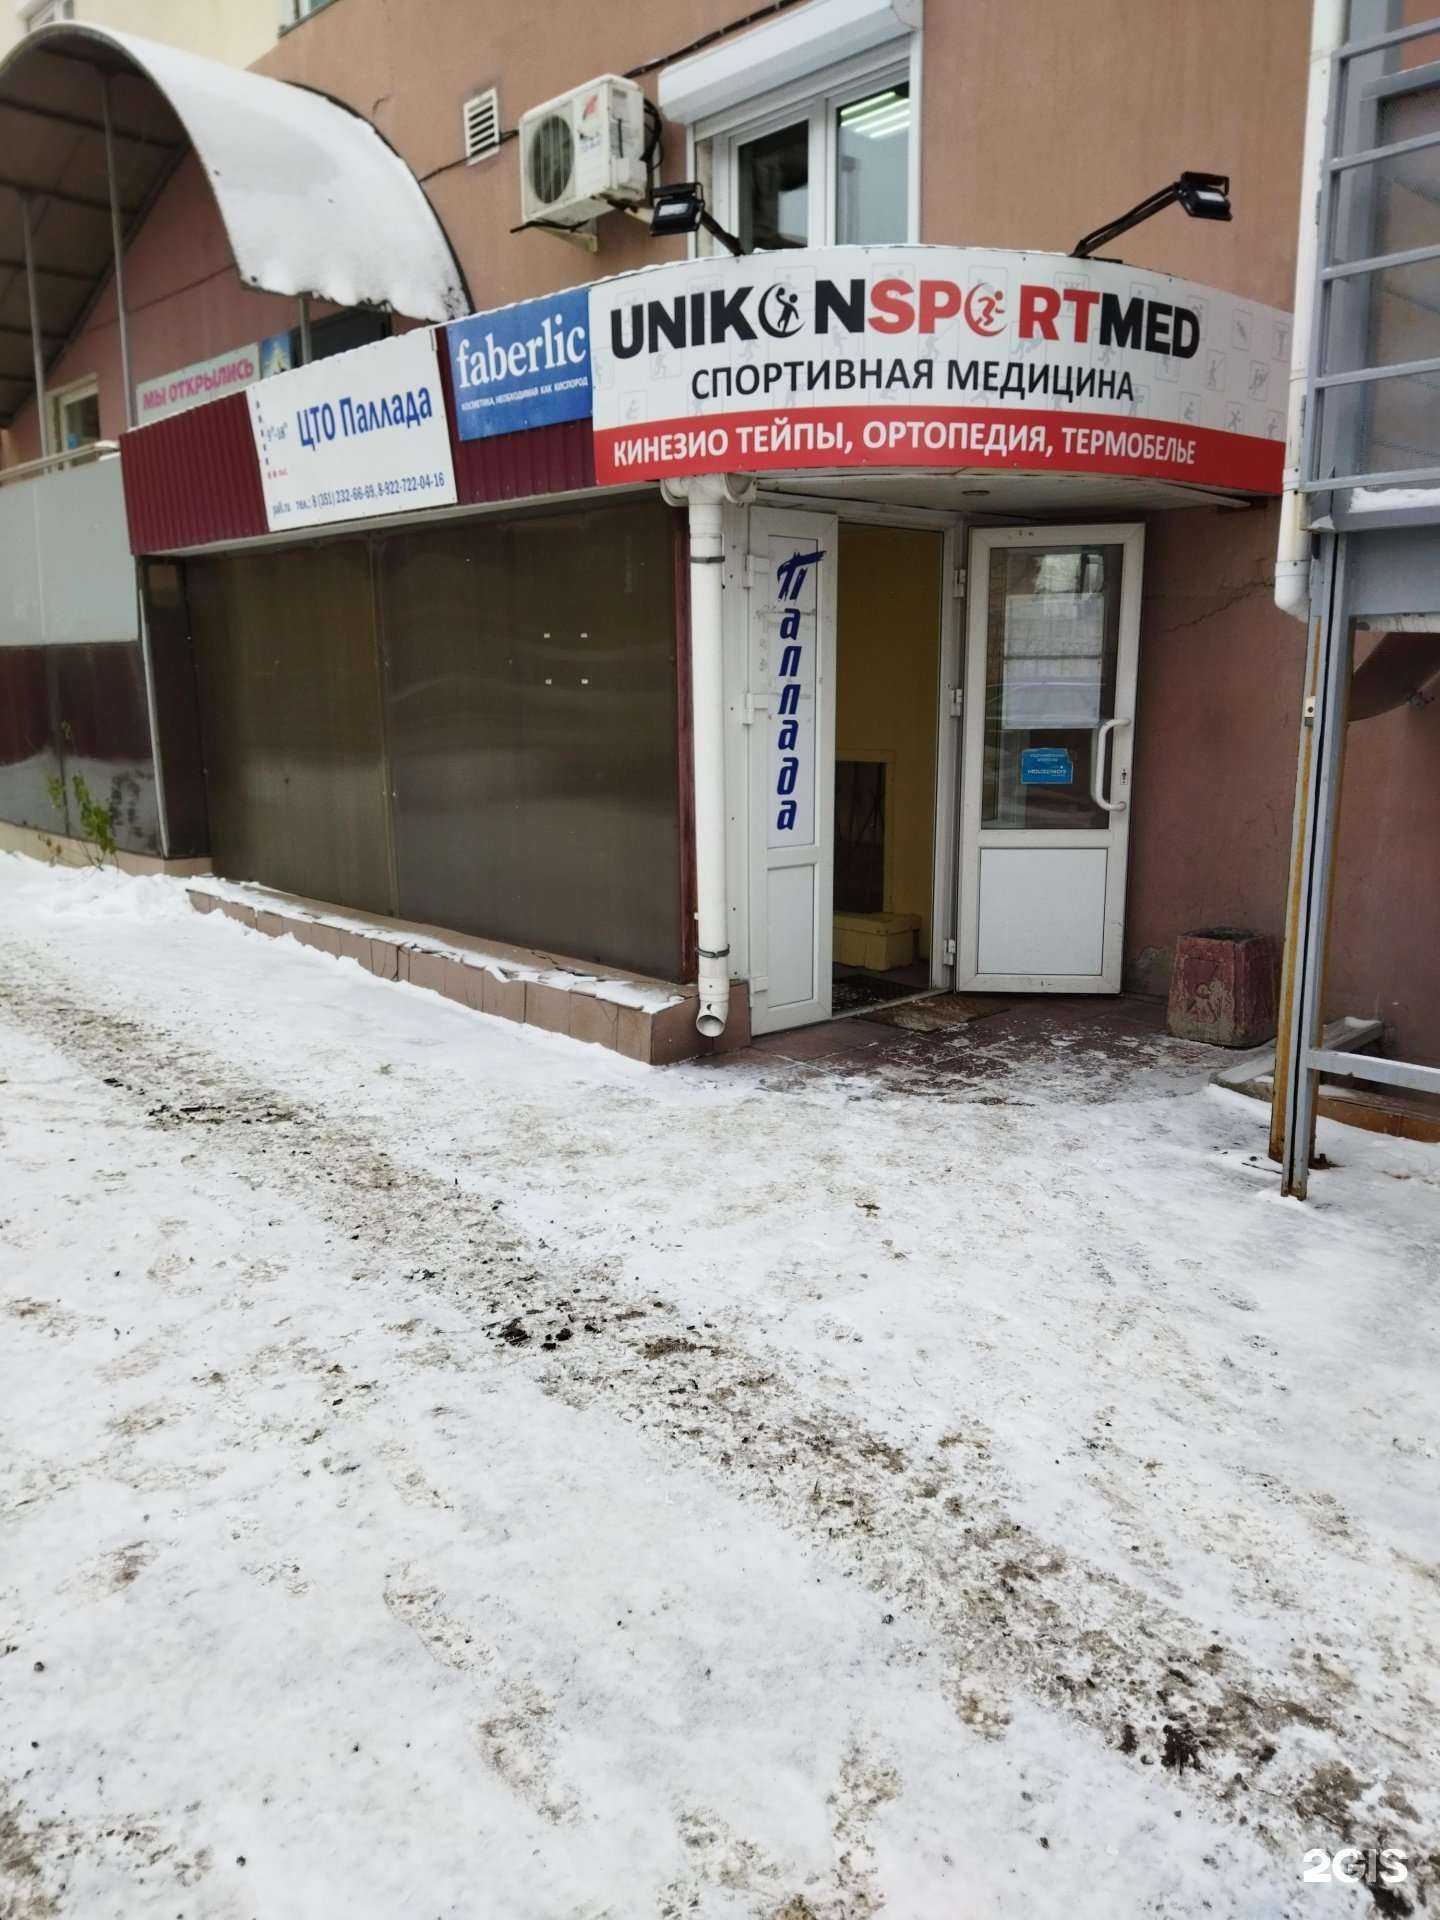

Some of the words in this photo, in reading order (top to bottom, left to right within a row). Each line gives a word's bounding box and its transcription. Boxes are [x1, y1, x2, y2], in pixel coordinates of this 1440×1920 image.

[457, 314, 586, 388] faberlic
[143, 388, 168, 410] МЫ
[169, 357, 255, 402] ОТКРЫЛИСЬ
[540, 384, 553, 395] КАК
[554, 376, 588, 393] КИСЛОРОД
[691, 358, 933, 400] СПОРТИВНАЯ
[948, 359, 1135, 402] МЕДИЦИНА
[297, 402, 336, 451] ЦТО
[339, 386, 433, 438] Паллада
[614, 428, 728, 467] КИНЕЗИО
[736, 418, 854, 455] ТЕЙПЫ,
[863, 420, 1055, 457] ОРТОПЕДИЯ,
[1062, 426, 1197, 465] ТЕРМОБЕЛЬЕ
